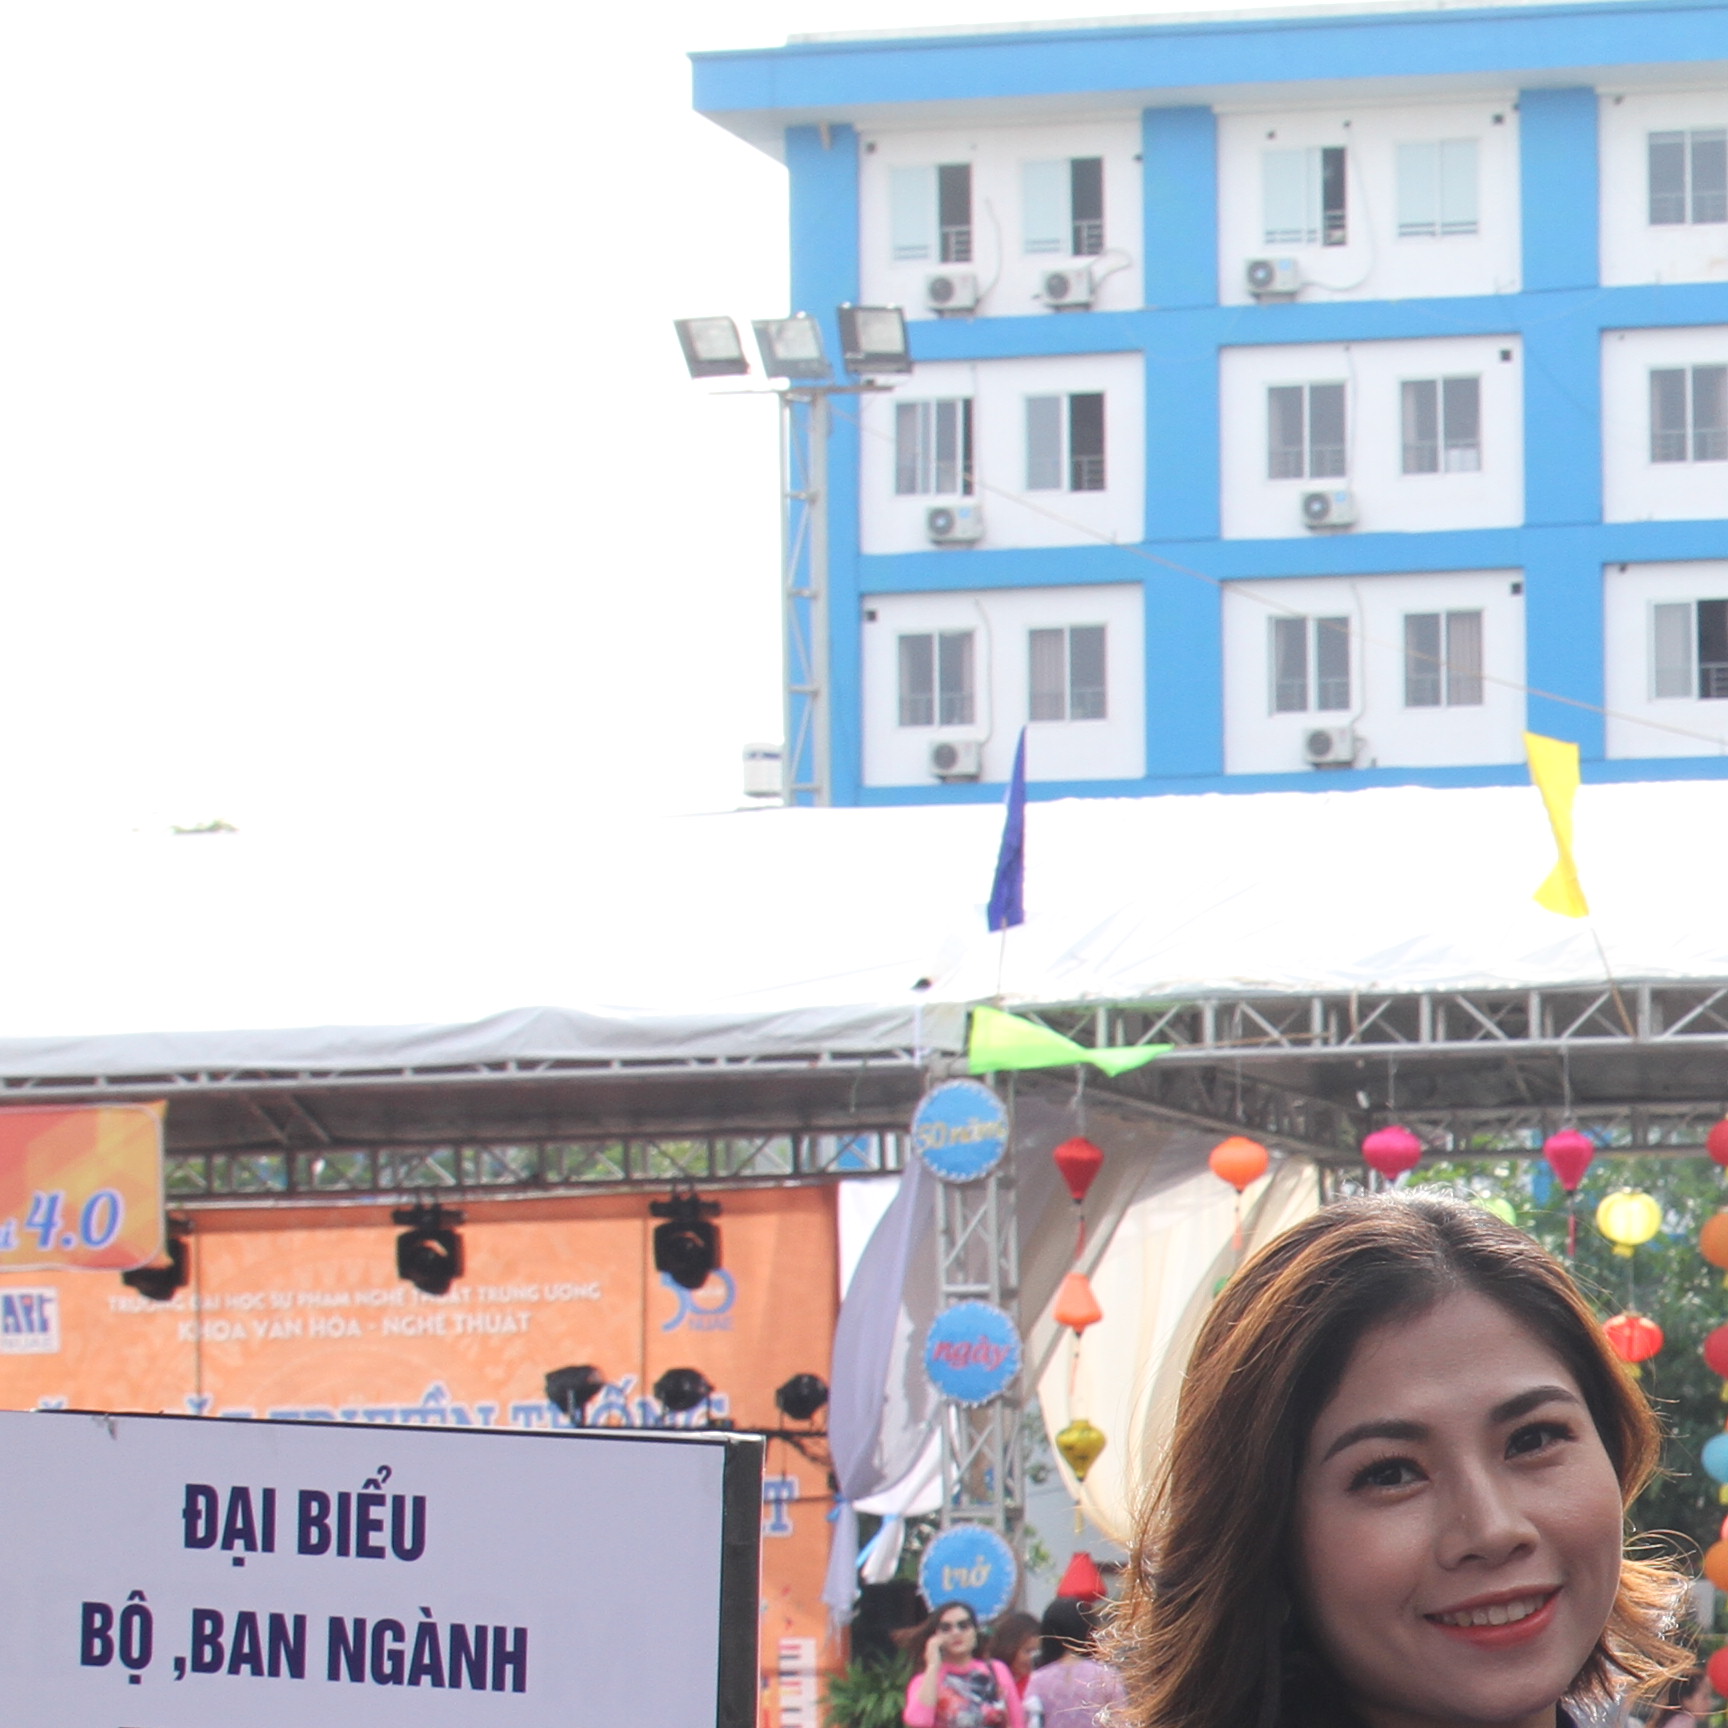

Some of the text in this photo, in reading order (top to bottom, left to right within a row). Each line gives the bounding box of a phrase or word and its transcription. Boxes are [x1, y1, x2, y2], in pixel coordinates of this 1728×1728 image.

[24, 1189, 123, 1249] 4.0
[182, 1464, 427, 1567] ĐẠI BIỂU
[80, 1589, 154, 1685] BỘ
[328, 1605, 529, 1693] NGÀNH
